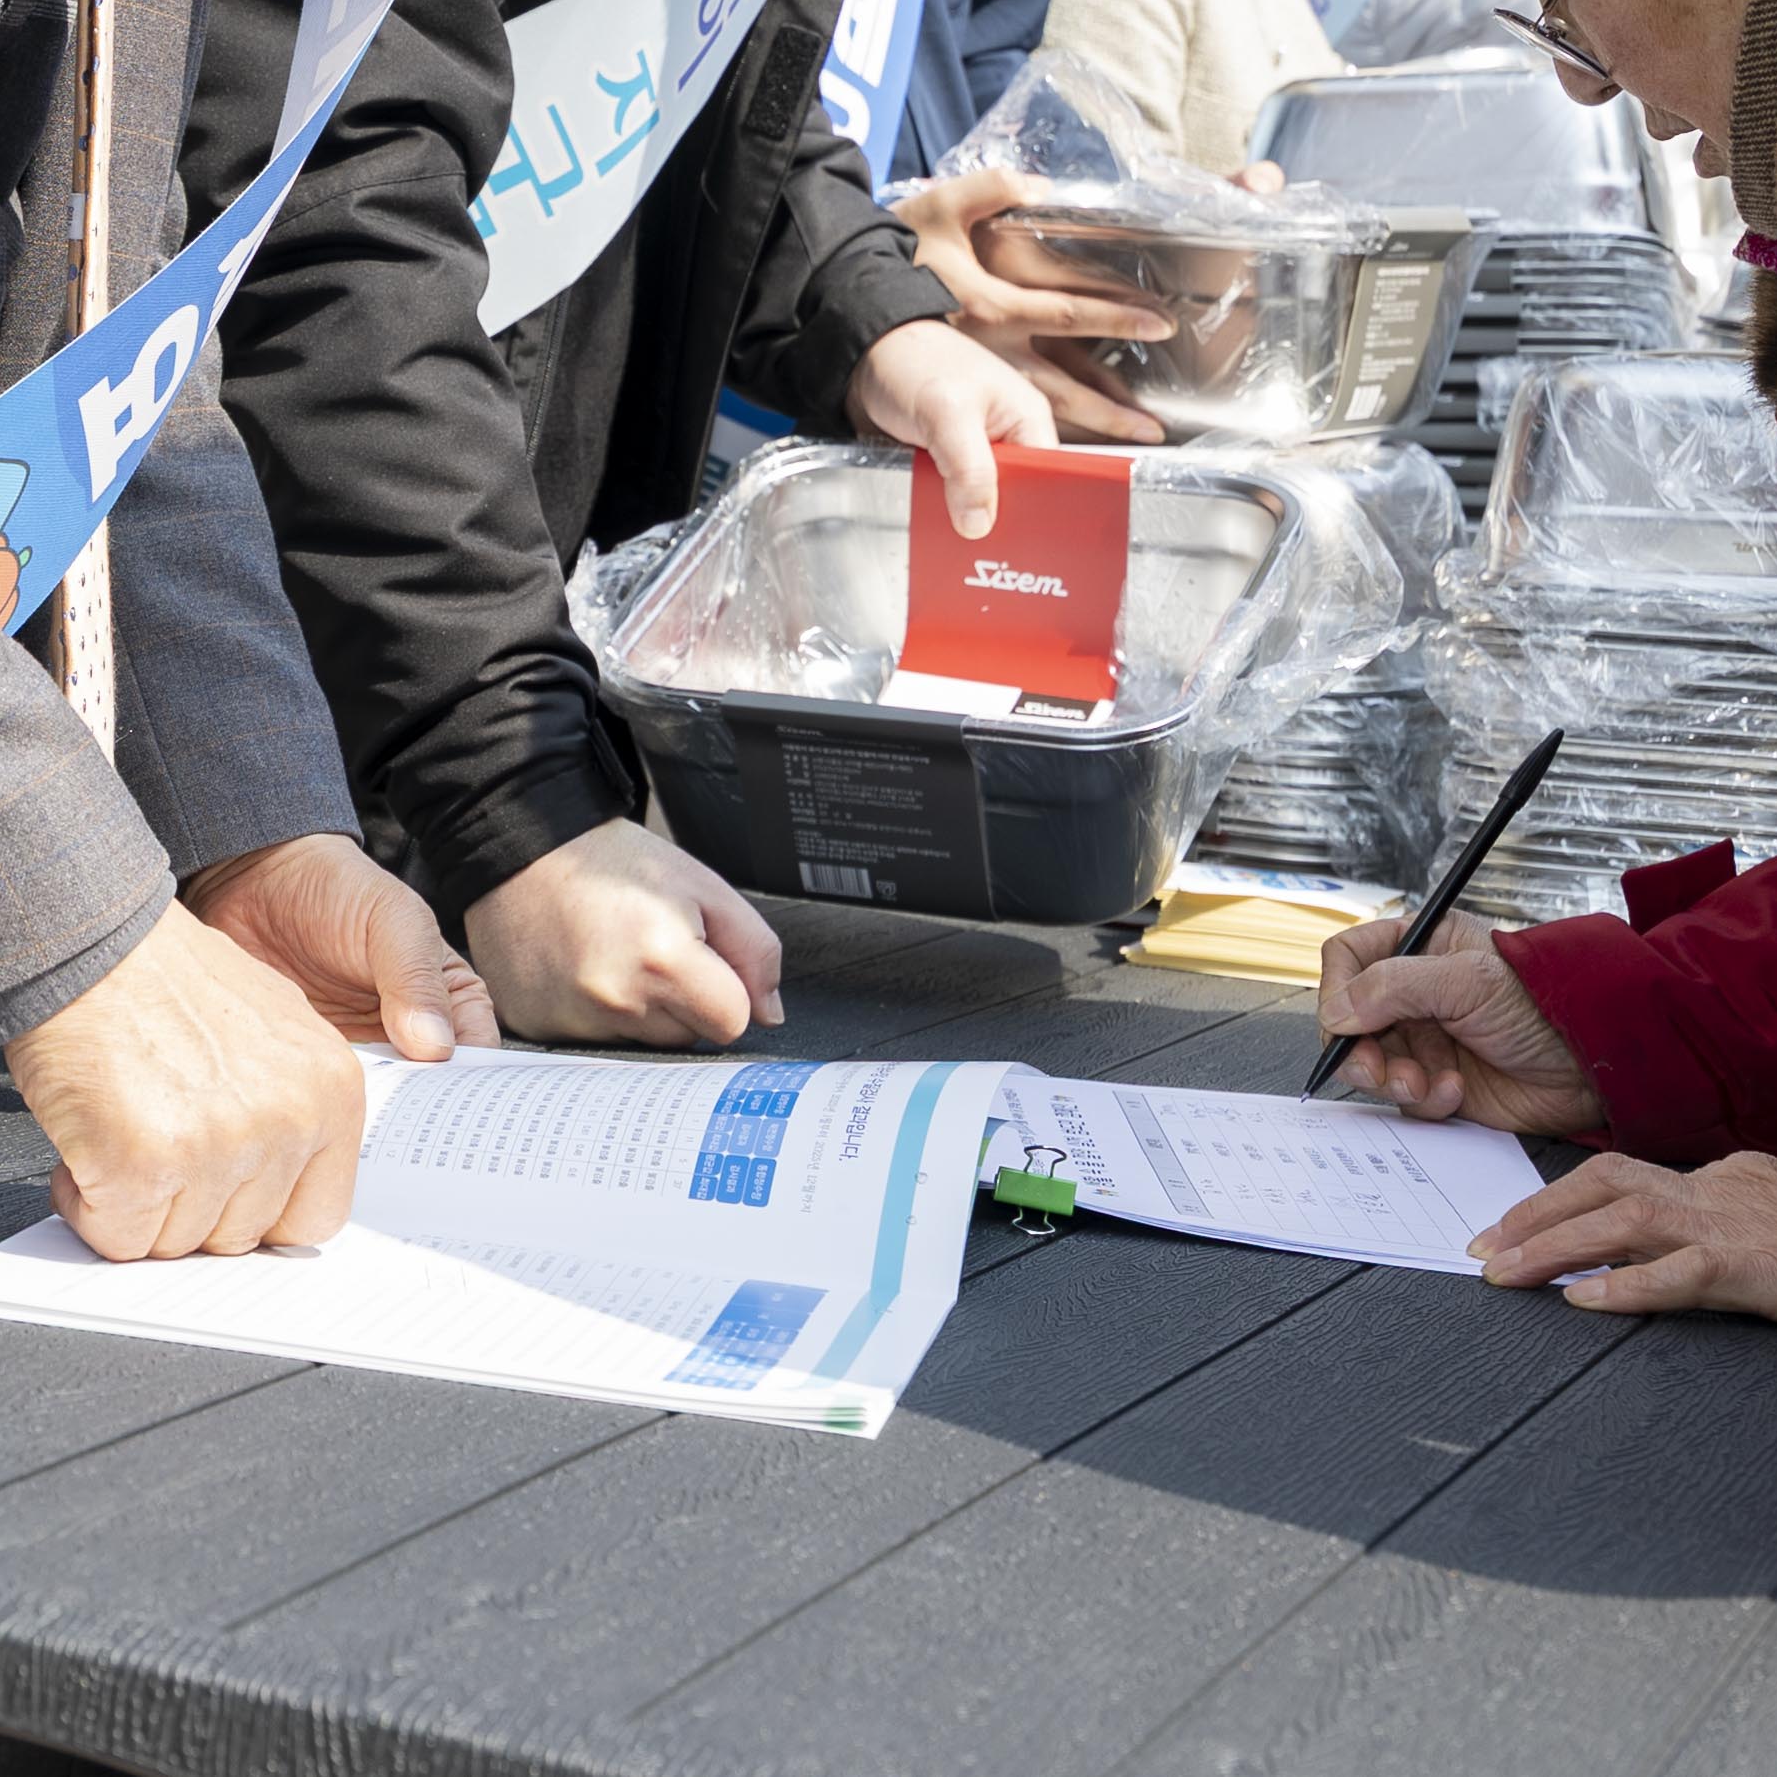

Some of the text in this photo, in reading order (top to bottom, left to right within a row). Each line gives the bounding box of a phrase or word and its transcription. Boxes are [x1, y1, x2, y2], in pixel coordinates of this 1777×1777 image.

[470, 46, 663, 241] 지구
[964, 559, 1069, 598] Sisem
[838, 1105, 872, 1162] 결과입니다.
